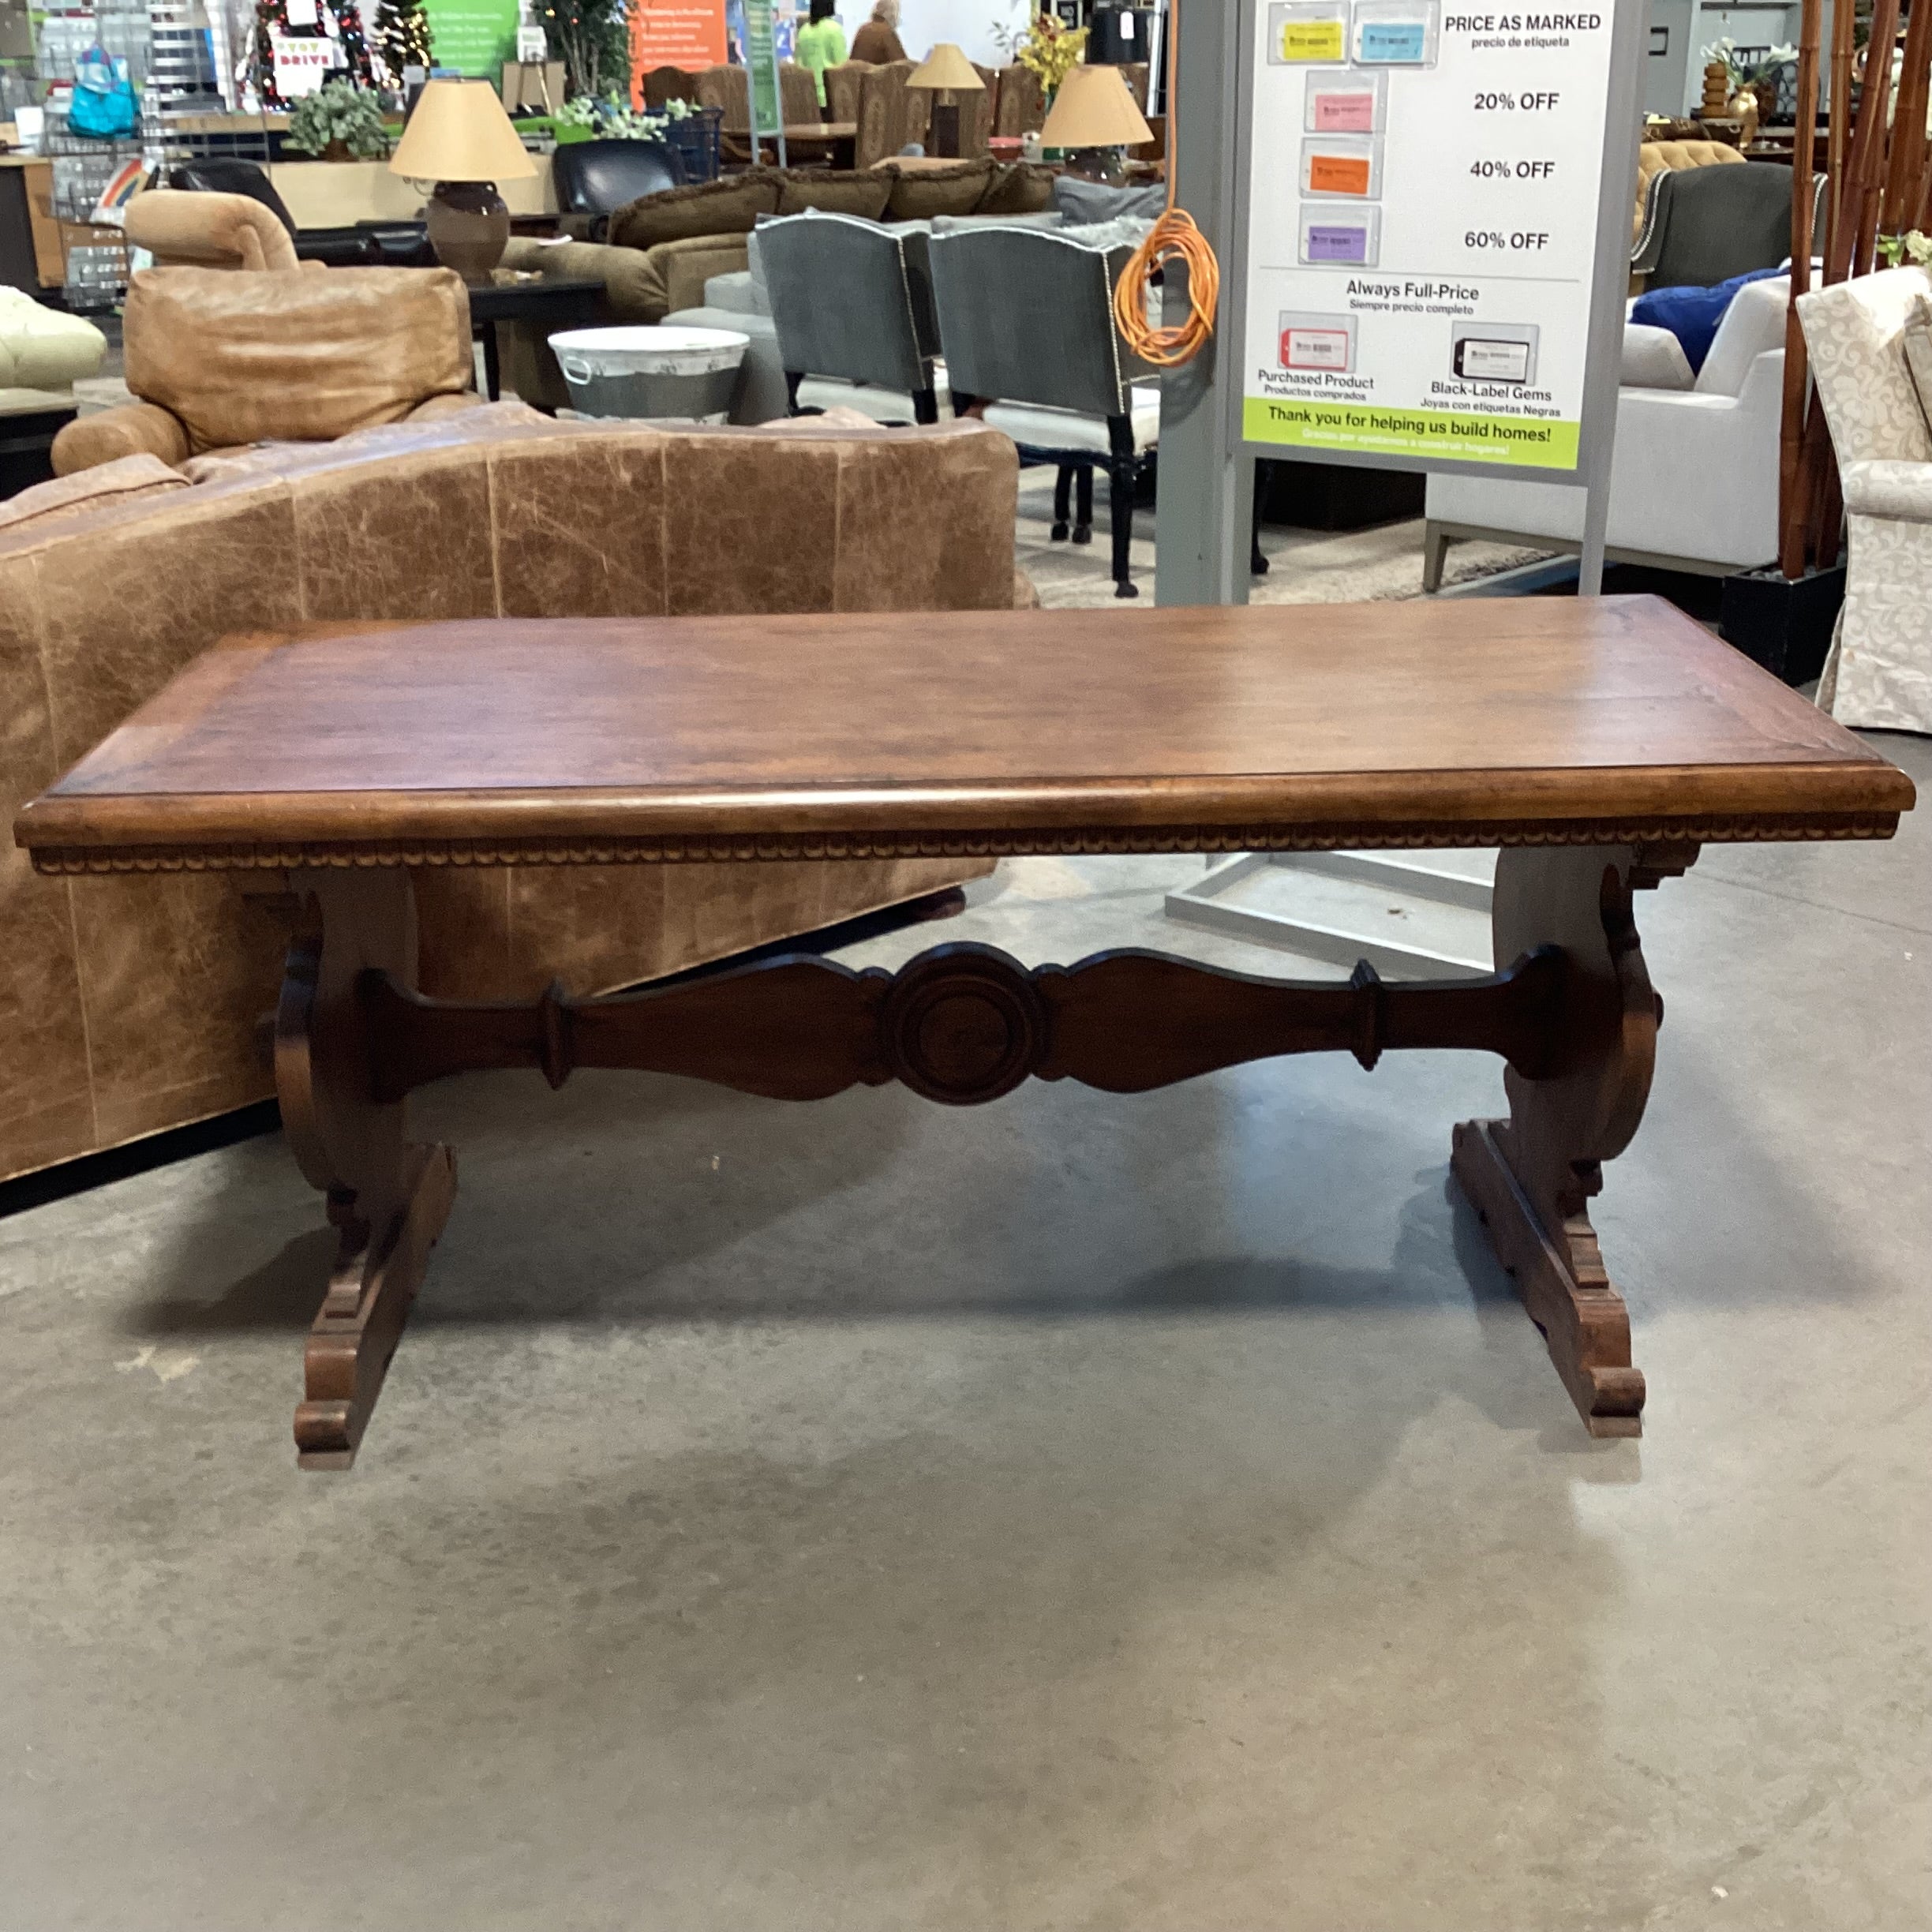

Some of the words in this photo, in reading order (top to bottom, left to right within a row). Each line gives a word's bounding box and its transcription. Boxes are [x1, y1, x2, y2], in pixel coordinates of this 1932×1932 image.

[1445, 16, 1495, 31] PRICE
[1499, 15, 1522, 30] AS
[1526, 14, 1601, 30] MARKED
[1471, 36, 1506, 49] precio
[1508, 36, 1522, 47] de
[1524, 36, 1570, 49] etiqueta
[1474, 92, 1515, 110] 20%
[1520, 92, 1559, 110] OFF
[1470, 161, 1511, 178] 40%
[1516, 161, 1555, 178] OFF
[1465, 231, 1505, 249] 60%
[1511, 232, 1549, 249] OFF
[1346, 279, 1400, 299] Always
[1405, 283, 1479, 300] Full-Price
[1350, 299, 1390, 311] Siempre
[1392, 301, 1423, 313] precio
[1426, 303, 1473, 316] completo
[1258, 369, 1322, 385] Purchased
[1325, 374, 1374, 389] Product
[1264, 384, 1311, 396] Productos
[1313, 389, 1366, 401] comprados
[1431, 381, 1509, 398] Black-Label
[1513, 387, 1552, 401] Gems
[1421, 397, 1449, 410] Joyas
[1452, 401, 1470, 410] con
[1473, 401, 1521, 414] etiquetas
[1524, 405, 1561, 417] Negras
[1268, 406, 1312, 422] Thank
[1316, 413, 1341, 426] you
[1346, 412, 1367, 427] for
[1371, 414, 1425, 435] helping
[1429, 422, 1446, 433] us
[1451, 420, 1488, 437] build
[1493, 425, 1551, 442] homes!
